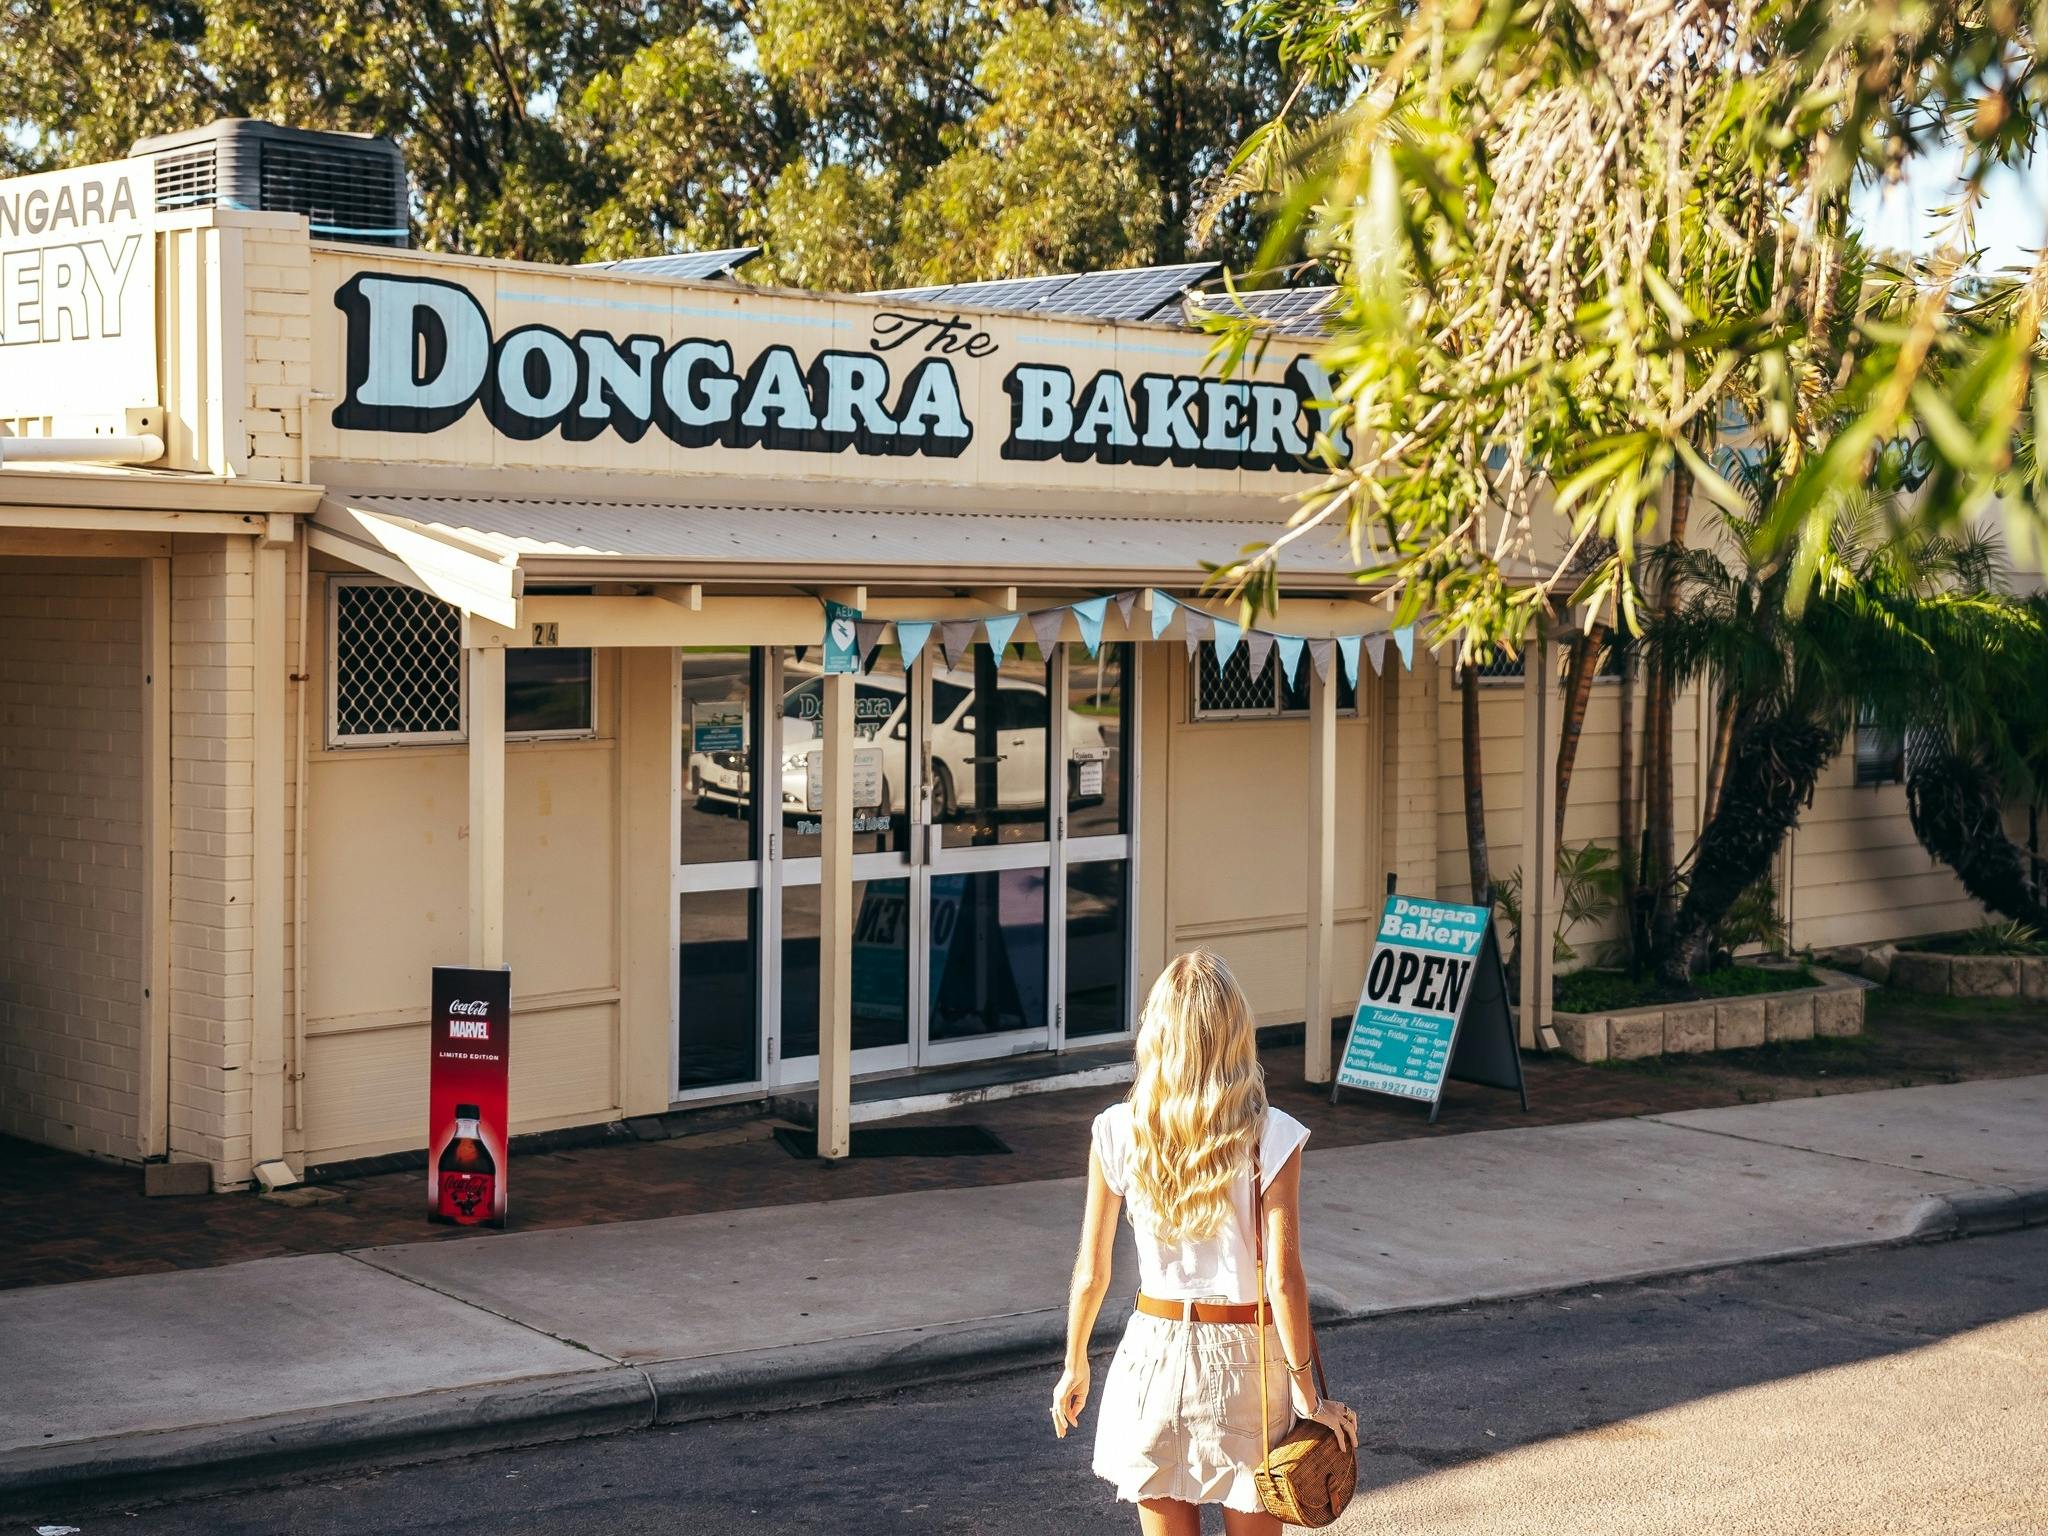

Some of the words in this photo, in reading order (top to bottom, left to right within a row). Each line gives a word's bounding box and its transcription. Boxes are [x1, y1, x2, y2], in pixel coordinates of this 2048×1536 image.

[870, 312, 999, 358] The
[332, 271, 974, 458] DONGARA
[835, 606, 854, 617] AED
[535, 624, 556, 645] 24
[1394, 899, 1477, 925] Dongara
[1380, 914, 1481, 953] Bakery
[1367, 948, 1471, 1014] OPEN
[449, 1020, 490, 1039] MARVEL
[1372, 1010, 1409, 1029] Trading
[1410, 1016, 1440, 1030] Hours
[1352, 1034, 1383, 1049] Saturday
[1355, 1024, 1382, 1038] Monday
[1387, 1029, 1409, 1042] Friday
[439, 1051, 468, 1059] LIMITED
[469, 1053, 499, 1061] EDITION
[1350, 1045, 1376, 1059] Sunday
[1346, 1056, 1368, 1068] Public
[1340, 1073, 1380, 1088] Phone:
